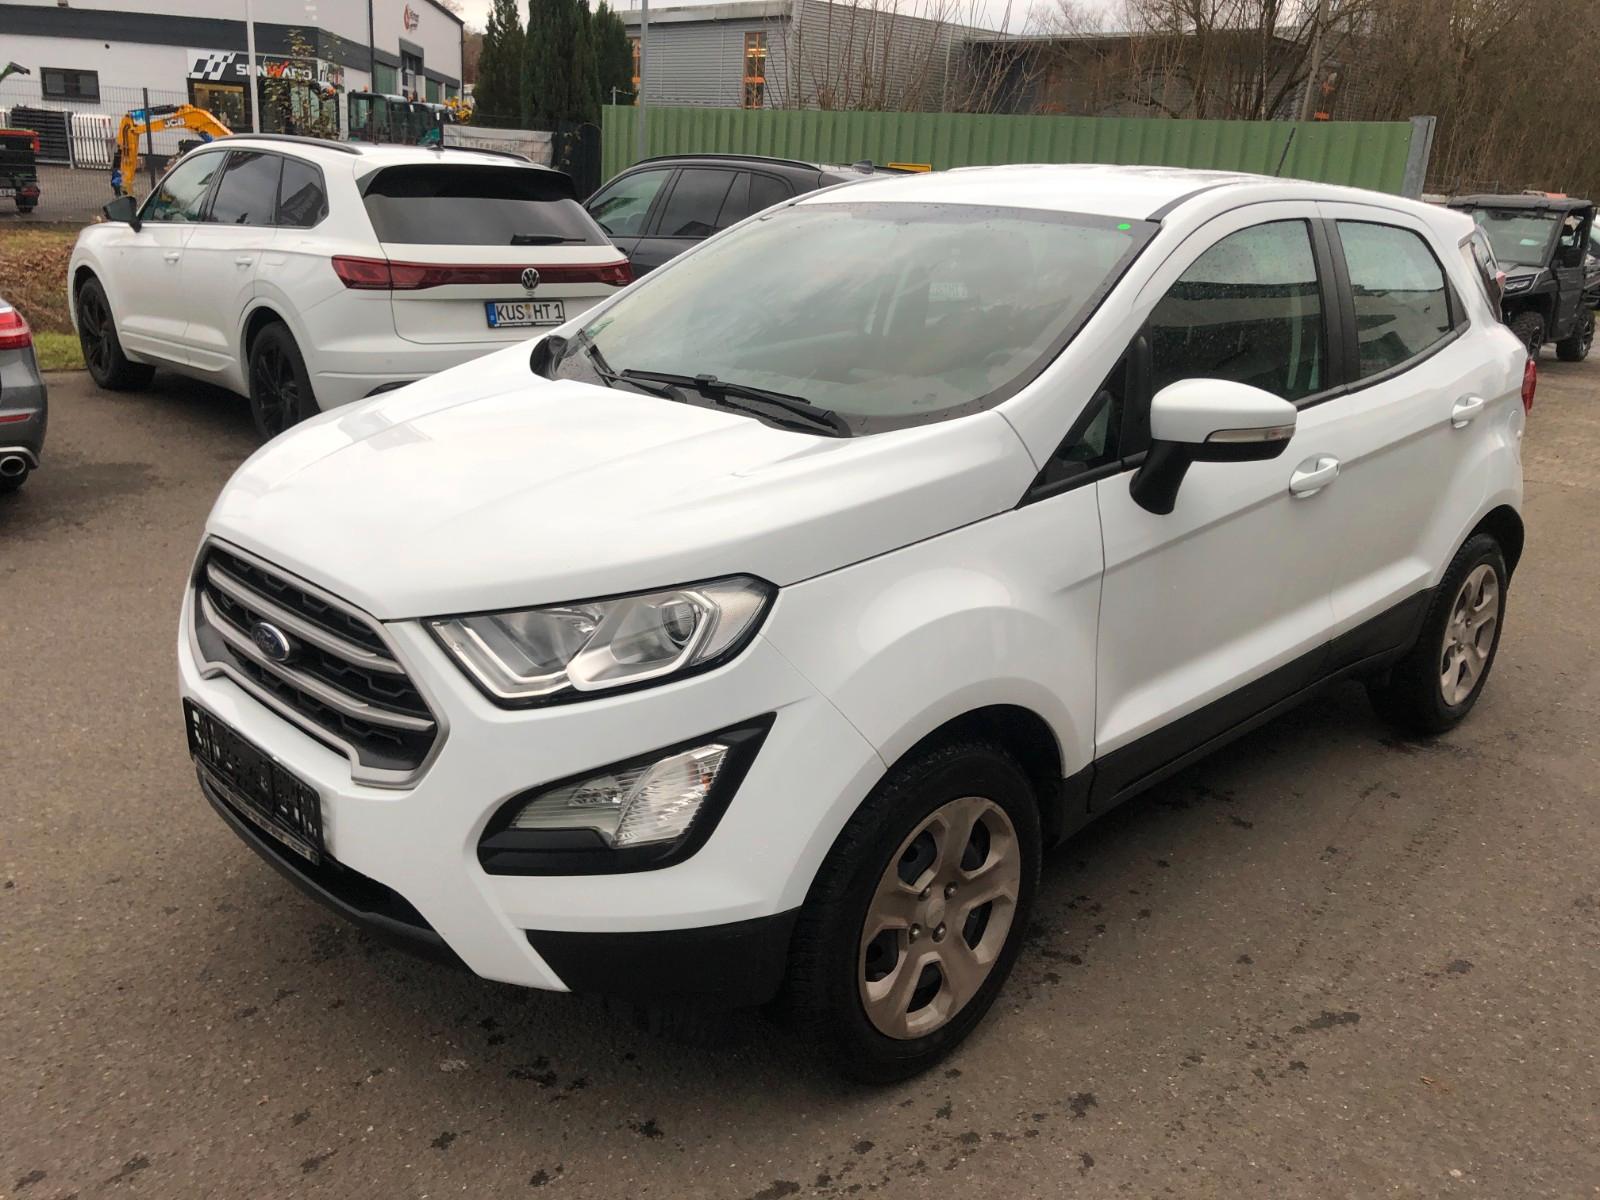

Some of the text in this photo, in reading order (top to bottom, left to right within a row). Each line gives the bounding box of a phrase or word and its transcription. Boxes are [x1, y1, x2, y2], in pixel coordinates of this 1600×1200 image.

[165, 117, 186, 127] JCB
[496, 303, 564, 321] KUS HT 1
